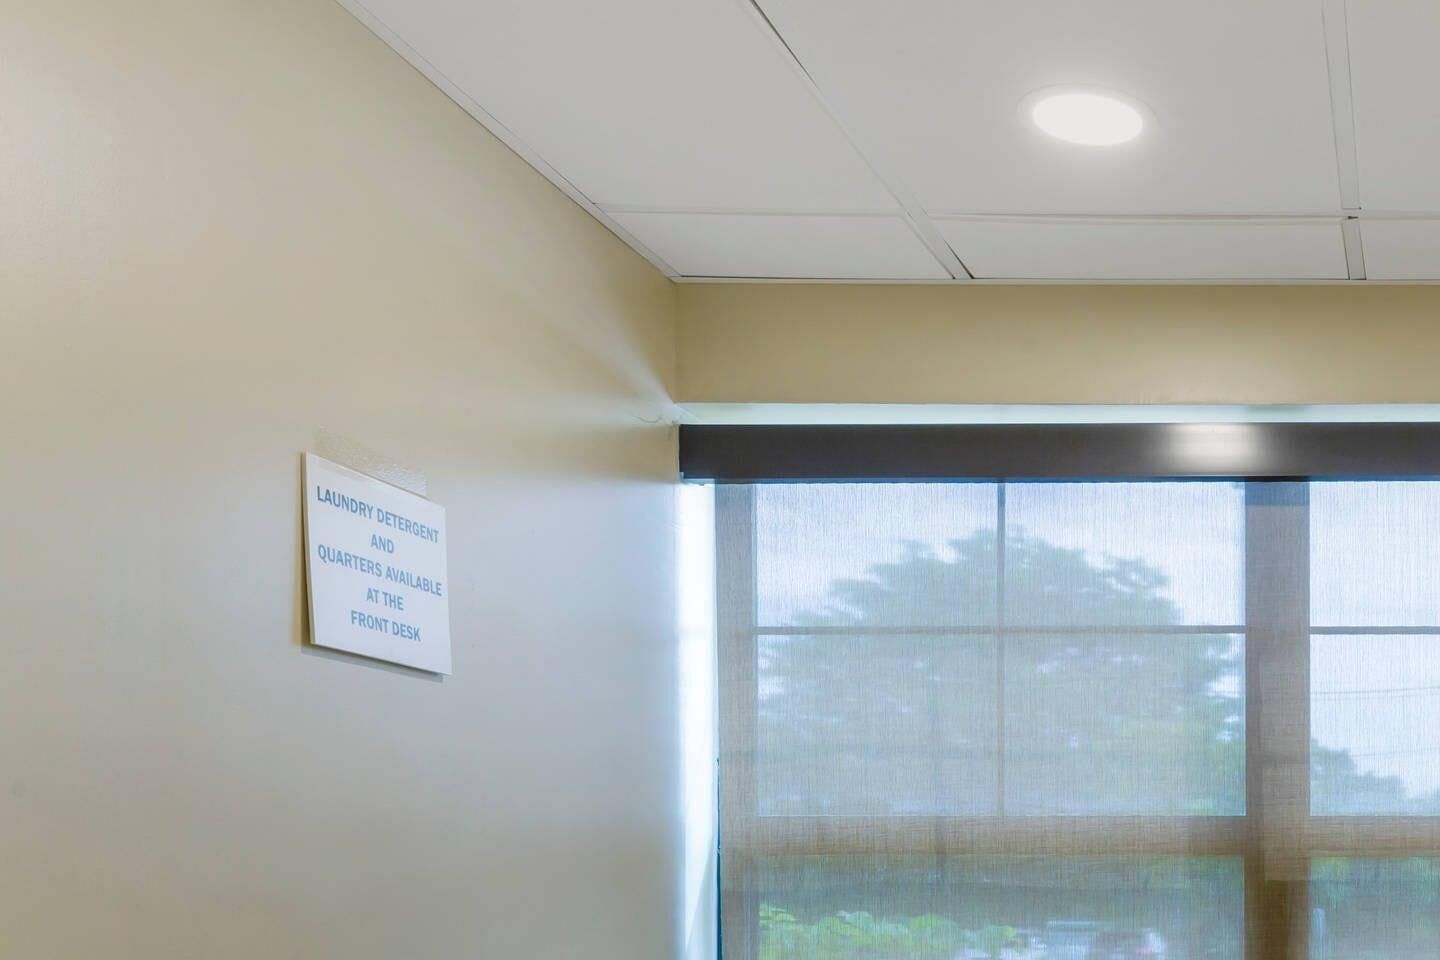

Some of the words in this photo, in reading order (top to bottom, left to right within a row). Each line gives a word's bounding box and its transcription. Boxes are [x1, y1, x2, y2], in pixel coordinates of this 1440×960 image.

[317, 486, 373, 522] LAUNDRY
[377, 508, 439, 544] DETERGENT
[371, 534, 394, 554] AND
[318, 544, 382, 577] QUARTERS
[385, 566, 442, 596] AVAILABLE
[366, 587, 380, 604] AT
[382, 592, 404, 611] THE
[351, 611, 389, 634] FRONT
[392, 622, 421, 642] DESK
